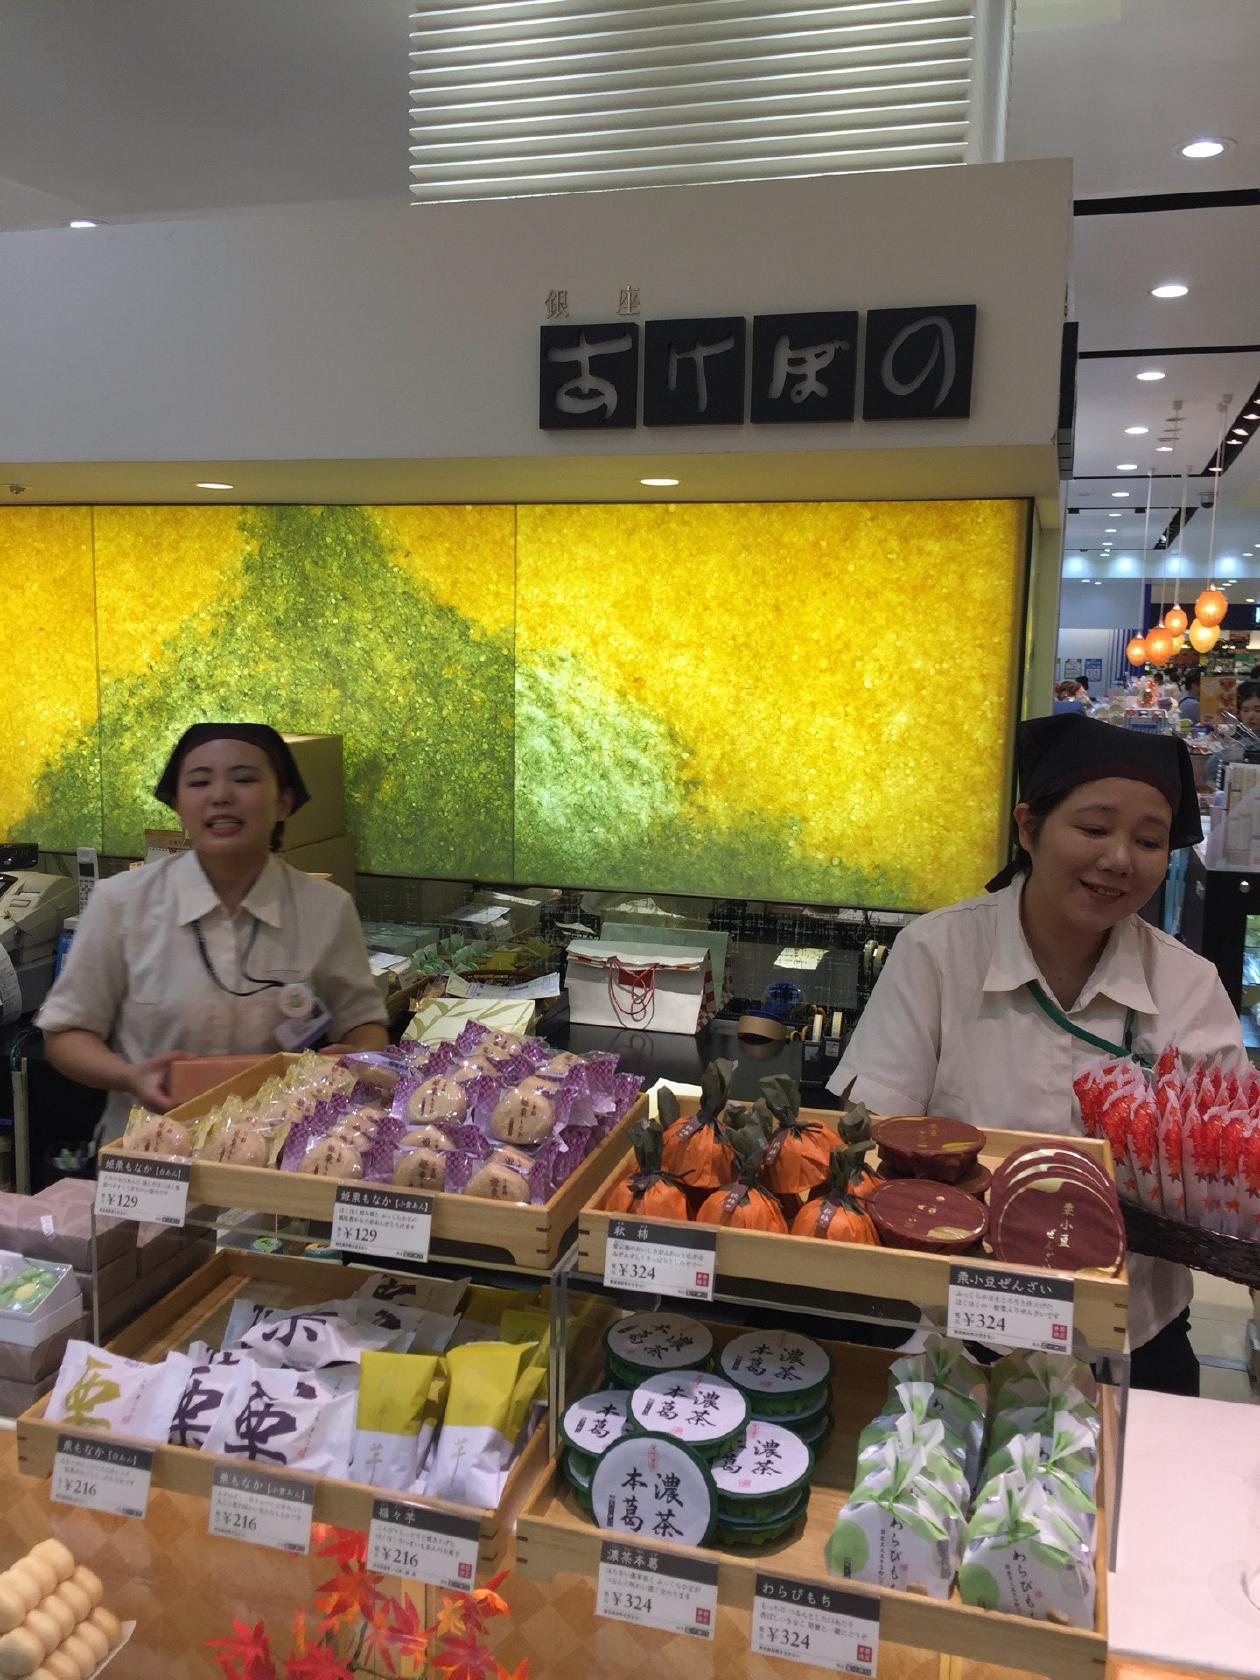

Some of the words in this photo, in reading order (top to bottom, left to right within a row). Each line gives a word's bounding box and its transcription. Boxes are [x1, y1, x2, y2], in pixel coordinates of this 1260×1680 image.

[545, 284, 641, 319] 銀座
[547, 315, 956, 421] あけぼの
[108, 1193, 138, 1208] ¥129
[344, 1227, 378, 1242] ¥129
[619, 1263, 656, 1280] ¥324
[956, 1271, 1053, 1294] 栗小豆ぜんざい
[964, 1312, 1006, 1331] ¥324
[745, 1343, 774, 1376] 本葛
[774, 1347, 806, 1381] 濃茶
[656, 1385, 689, 1420] 本葛
[685, 1391, 721, 1427] 濃茶
[588, 1403, 621, 1438] 本葛
[751, 1439, 782, 1476] 濃茶
[65, 1478, 97, 1497] ¥216
[620, 1466, 648, 1533] 本葛
[224, 1511, 257, 1531] ¥216
[652, 1471, 684, 1538] 濃茶
[382, 1547, 418, 1568] ¥216
[890, 1517, 904, 1589] わらびも
[762, 1583, 831, 1608] わらびもち
[1012, 1550, 1035, 1620] わらびも
[612, 1591, 653, 1613] ¥324
[768, 1627, 810, 1649] ¥324
